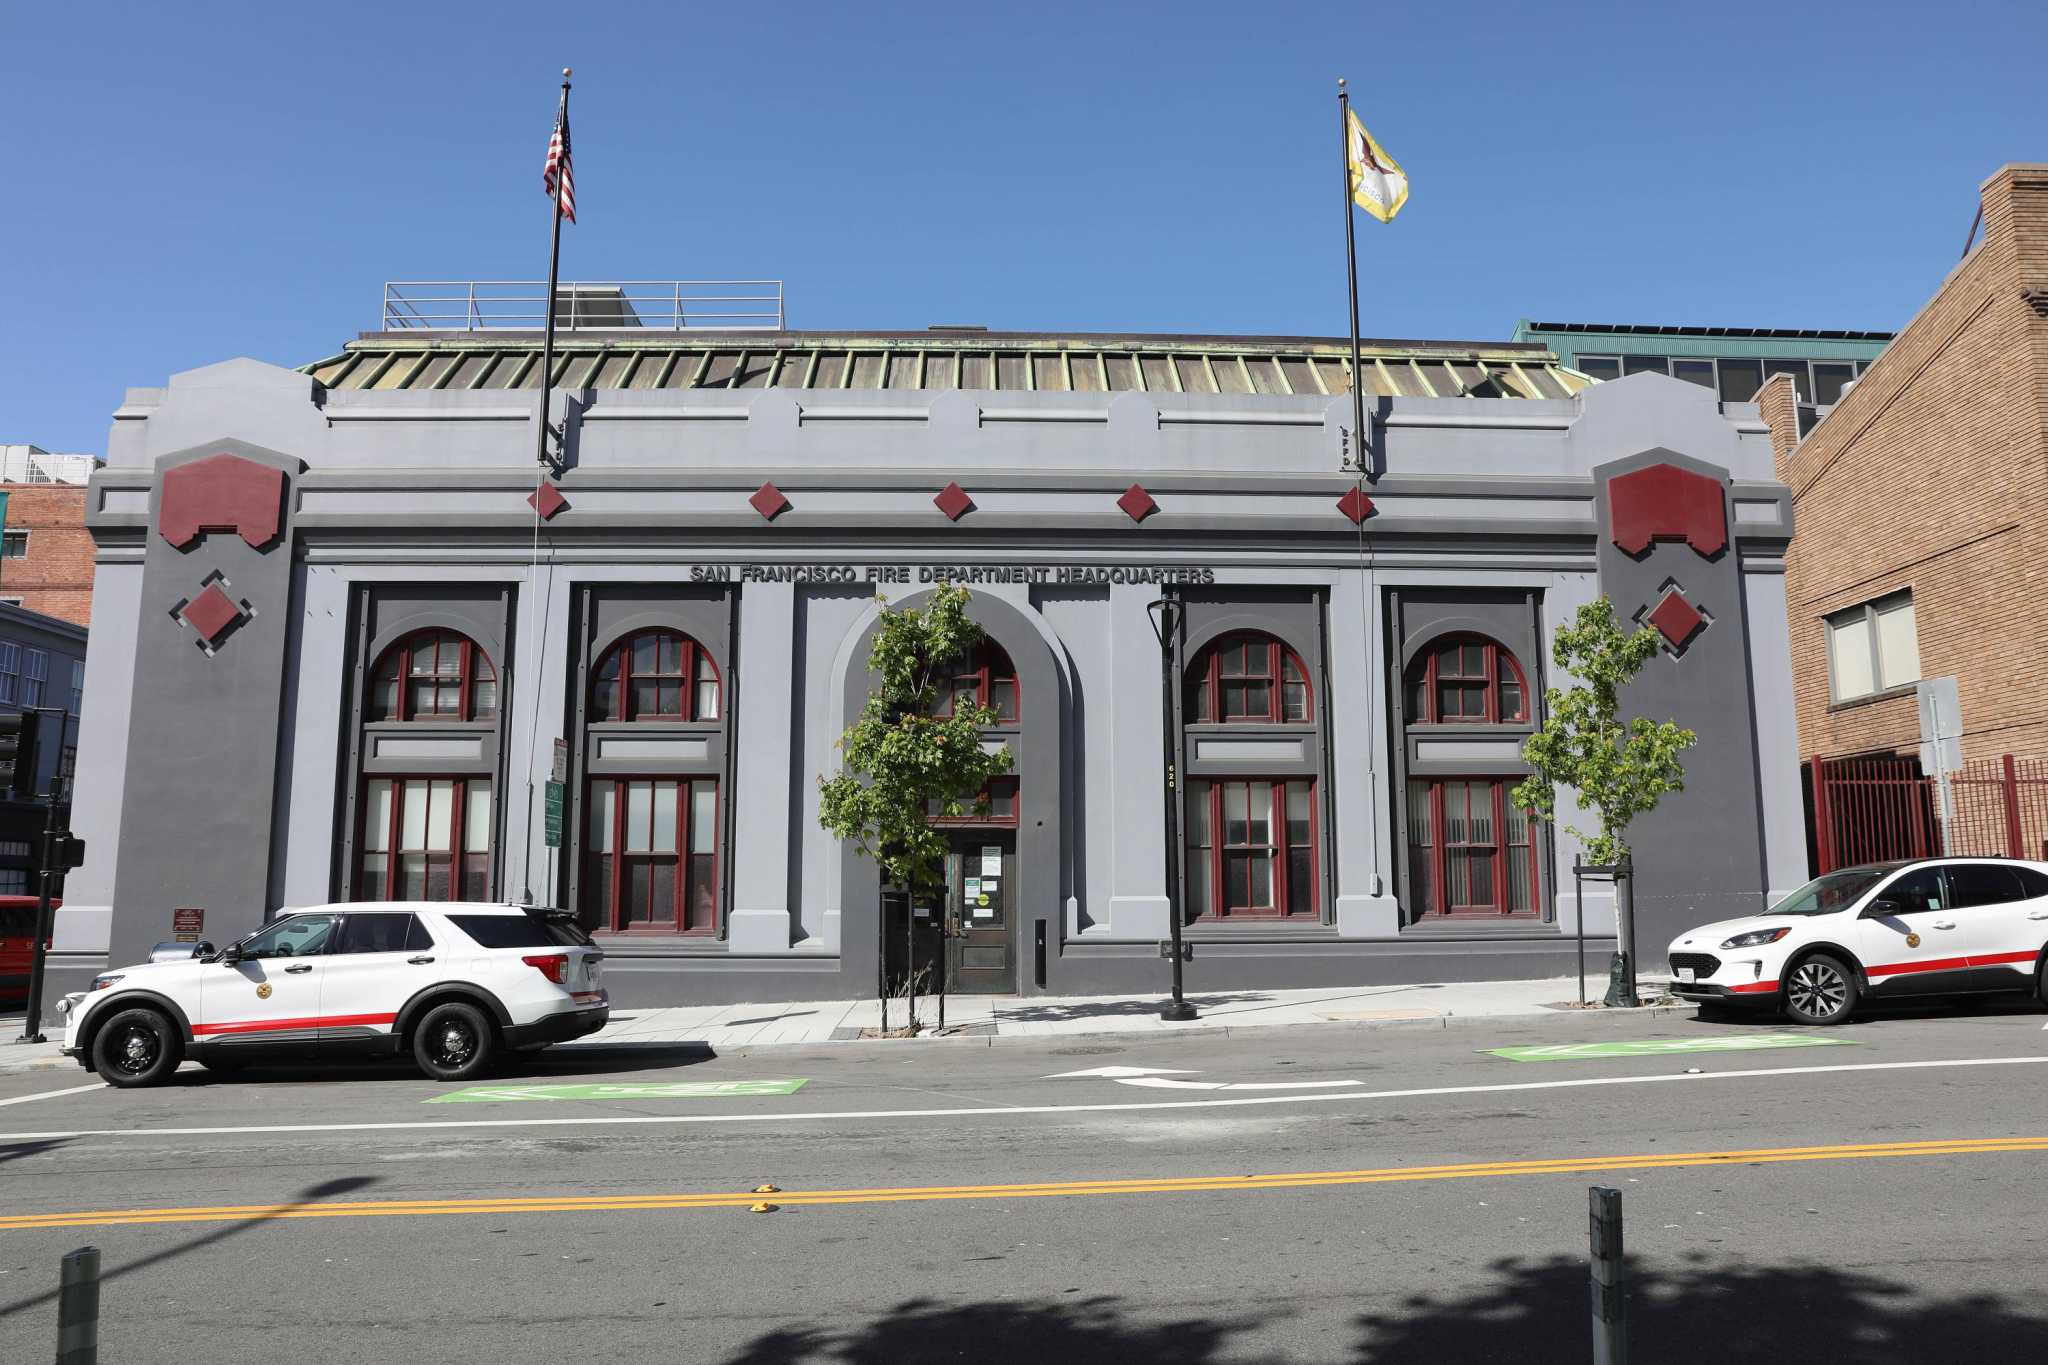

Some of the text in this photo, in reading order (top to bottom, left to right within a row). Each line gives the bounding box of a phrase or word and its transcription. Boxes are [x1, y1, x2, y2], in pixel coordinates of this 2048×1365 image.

[690, 566, 1215, 585] SAN FRANCISCO FIRE DEPARTMENT HEADQUARTERS
